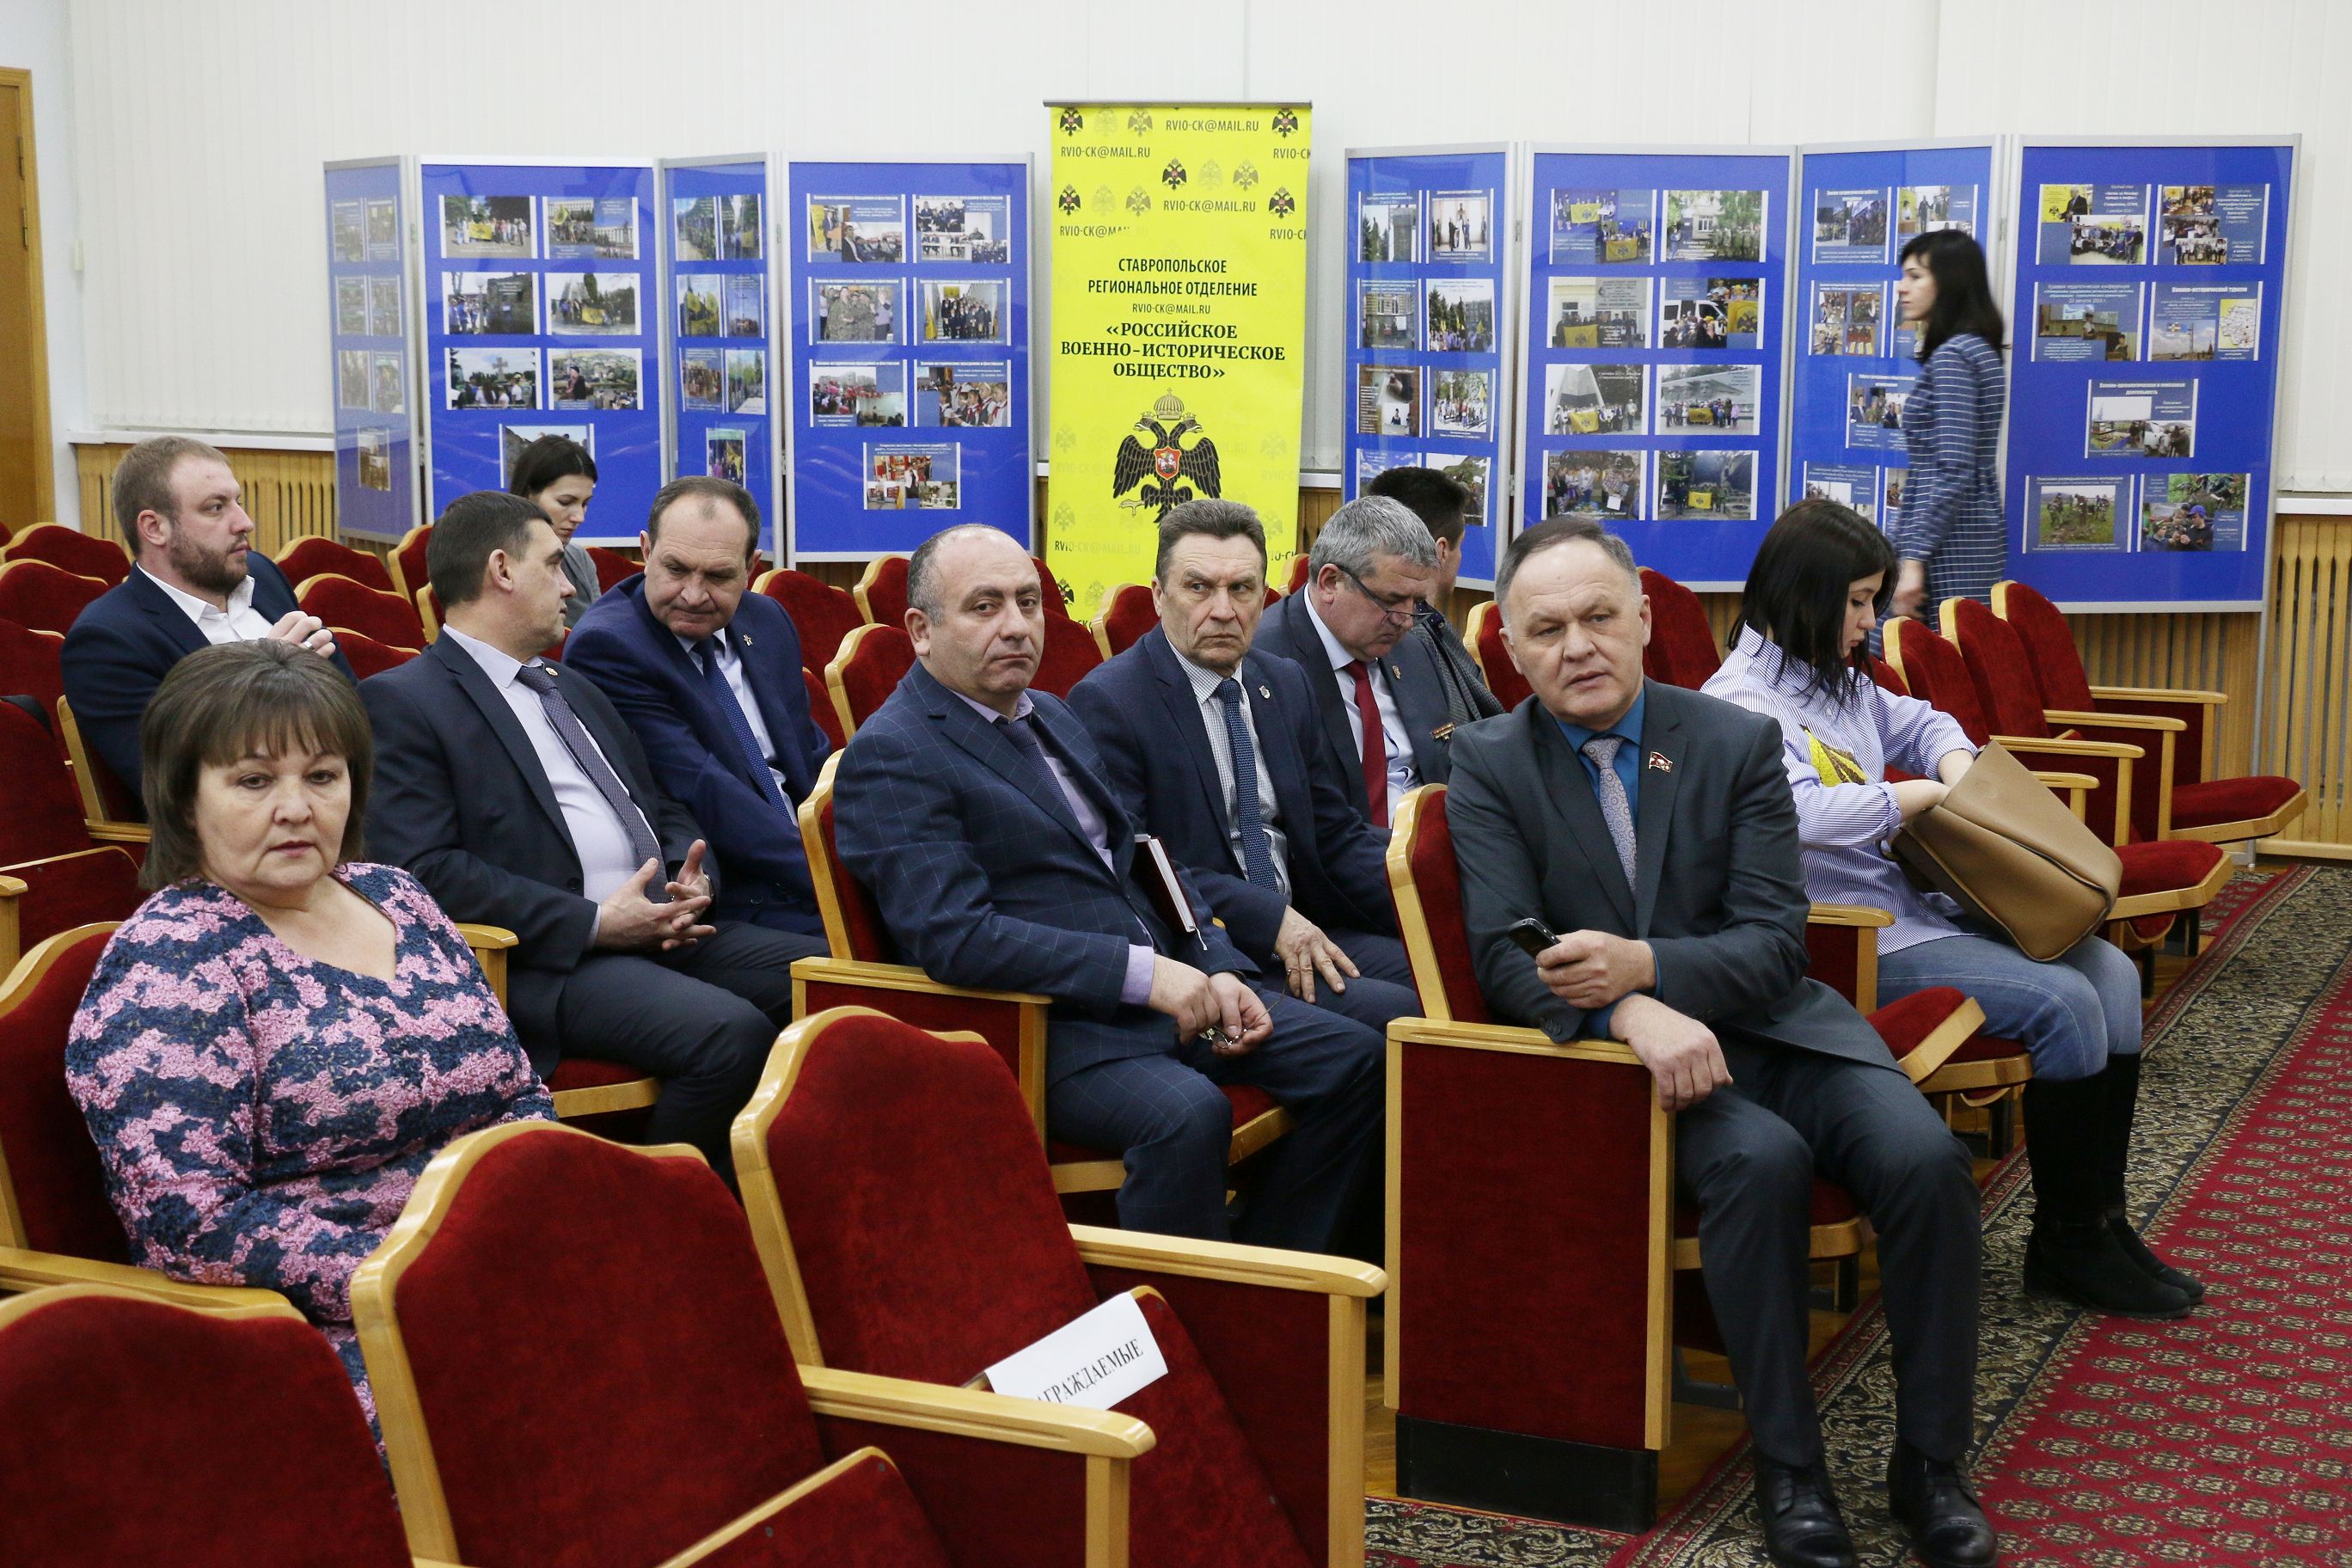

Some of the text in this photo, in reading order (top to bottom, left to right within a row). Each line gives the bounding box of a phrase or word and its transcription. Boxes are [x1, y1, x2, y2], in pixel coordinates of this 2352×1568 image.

[1166, 119, 1259, 132] RVIO-CK@MAIL.RU
[1061, 146, 1150, 158] RVIO-CK@MAIL.RU
[1164, 200, 1256, 213] RVIO-CK@MAIL.RU
[1118, 258, 1227, 273] СТАВРОПОЛЬСКОЕ
[1088, 280, 1258, 297] РЕГИОНАЛЬНОЕ ОТДЕЛЕНИЕ
[1132, 303, 1210, 315] RVIO-CK@MAIL.RU
[1106, 321, 1238, 339] «РОССИЙСКОЕ
[1061, 341, 1285, 361] ВОЕННО-ИСТОРИЧЕСКОЕ
[1113, 363, 1225, 380] ОБЩЕСТВО»
